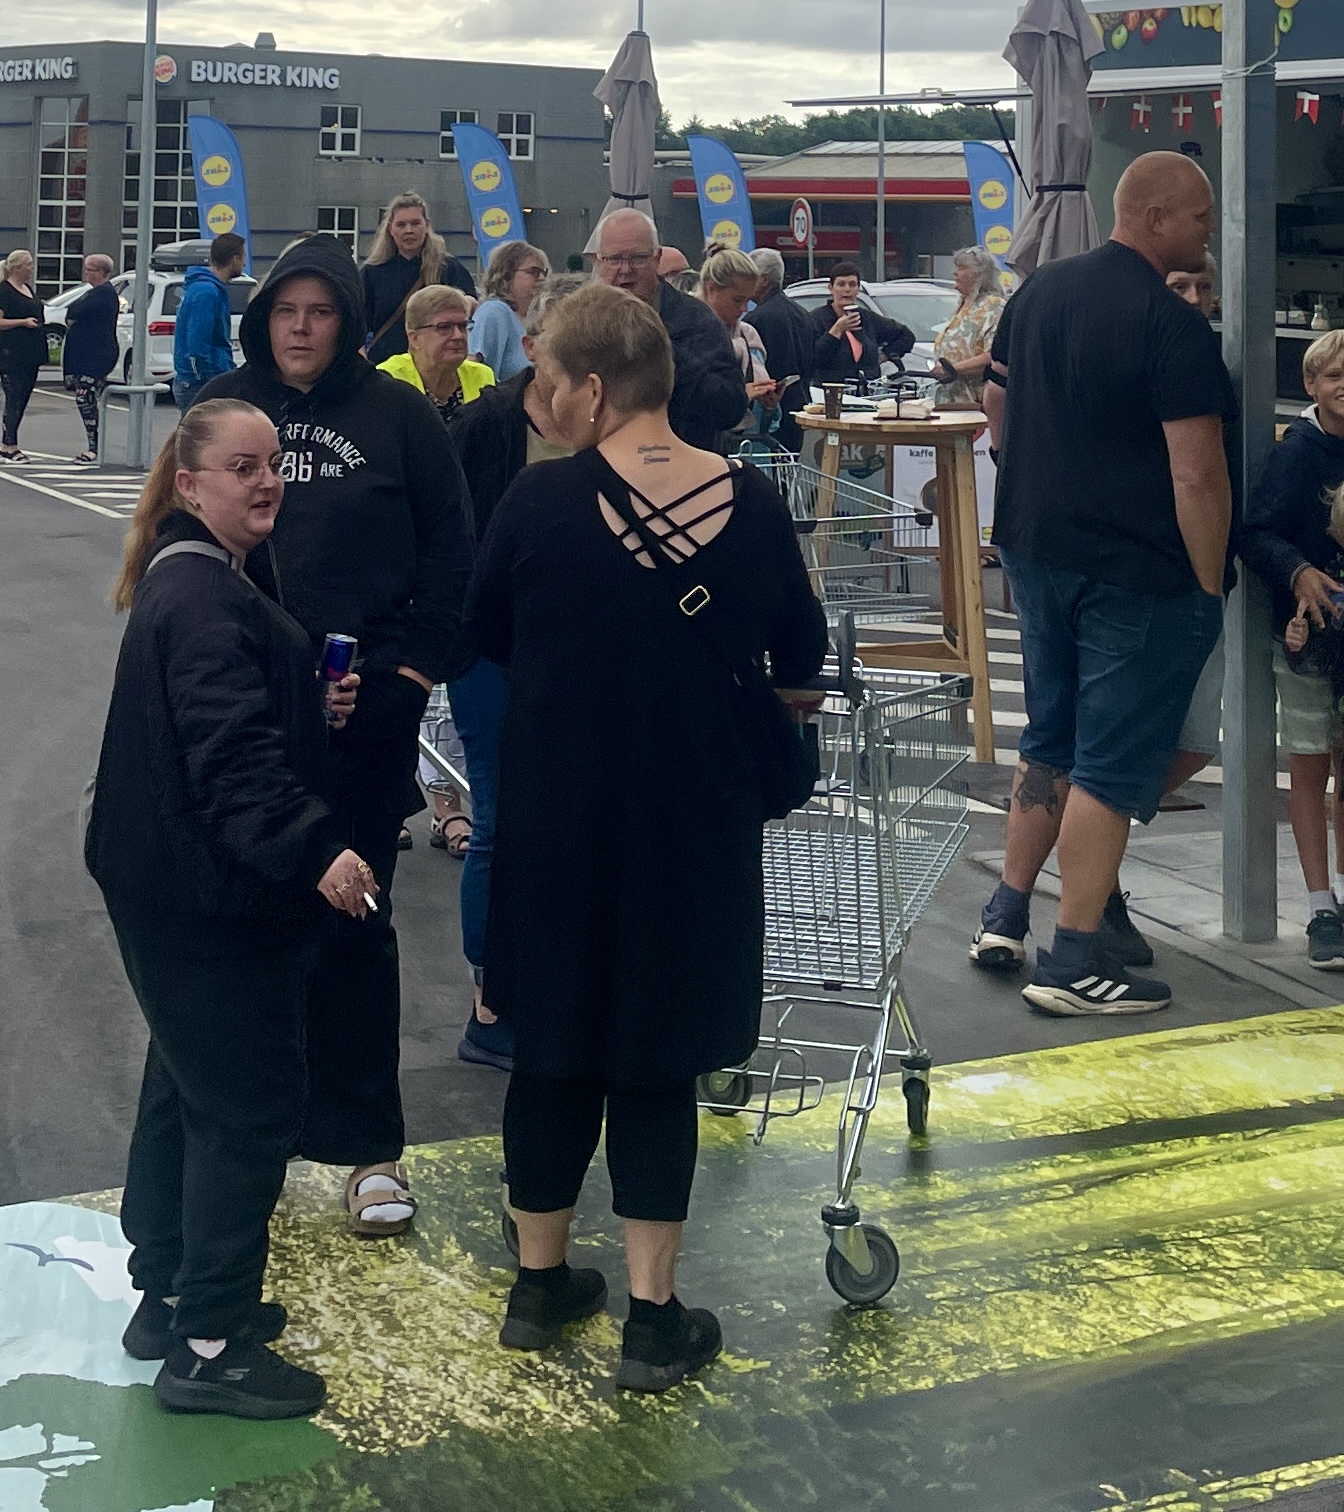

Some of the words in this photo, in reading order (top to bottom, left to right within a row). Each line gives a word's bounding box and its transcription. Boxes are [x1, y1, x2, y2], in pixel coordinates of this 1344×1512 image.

[35, 57, 73, 80] KING
[191, 60, 281, 86] BURGER
[285, 66, 340, 89] KING
